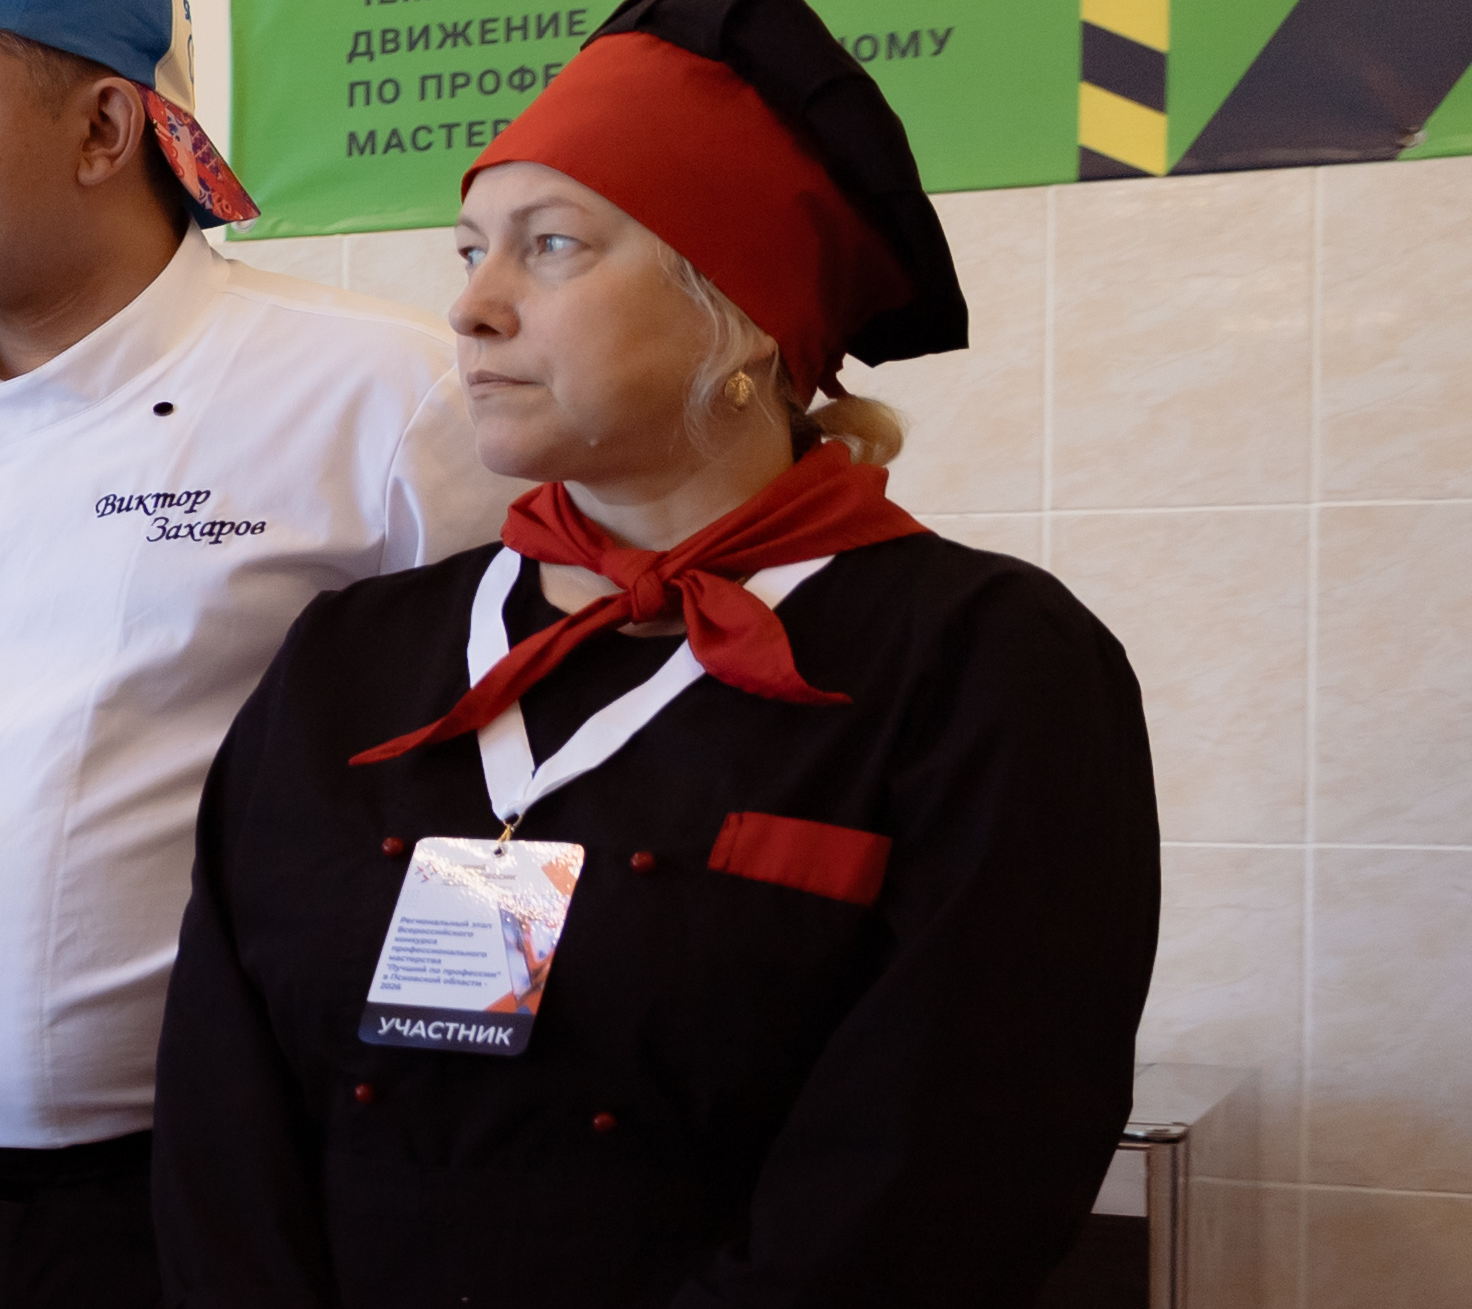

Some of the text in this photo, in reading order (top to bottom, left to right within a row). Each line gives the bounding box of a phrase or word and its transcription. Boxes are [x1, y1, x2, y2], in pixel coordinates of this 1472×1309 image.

[347, 8, 589, 64] ДВИЖЕНИЕ
[347, 78, 401, 108] ПО
[95, 489, 211, 518] Виктор
[146, 516, 267, 545] Захаров
[377, 1016, 514, 1047] УЧАСТНИК
